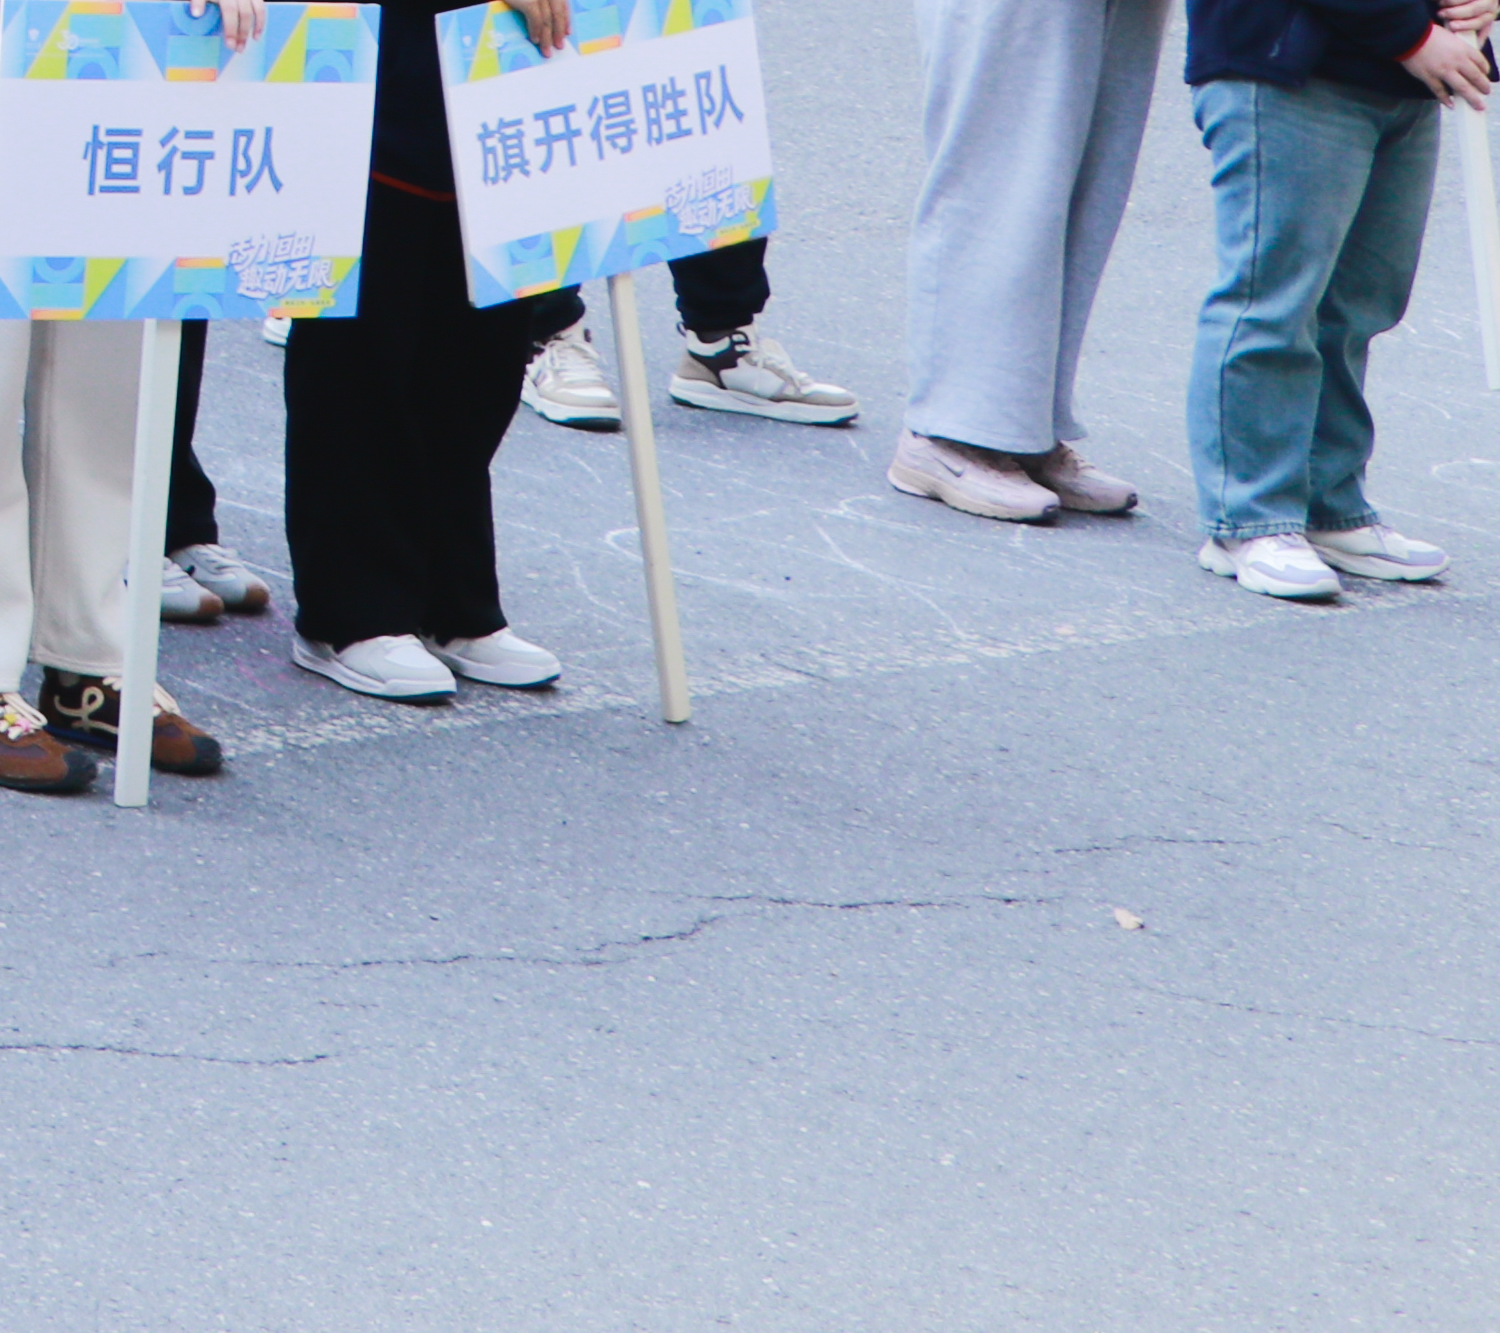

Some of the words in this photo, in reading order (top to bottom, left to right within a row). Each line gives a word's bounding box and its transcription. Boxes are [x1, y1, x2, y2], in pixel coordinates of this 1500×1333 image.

[82, 123, 284, 197] 恒行队
[477, 63, 744, 186] 旗开得胜队
